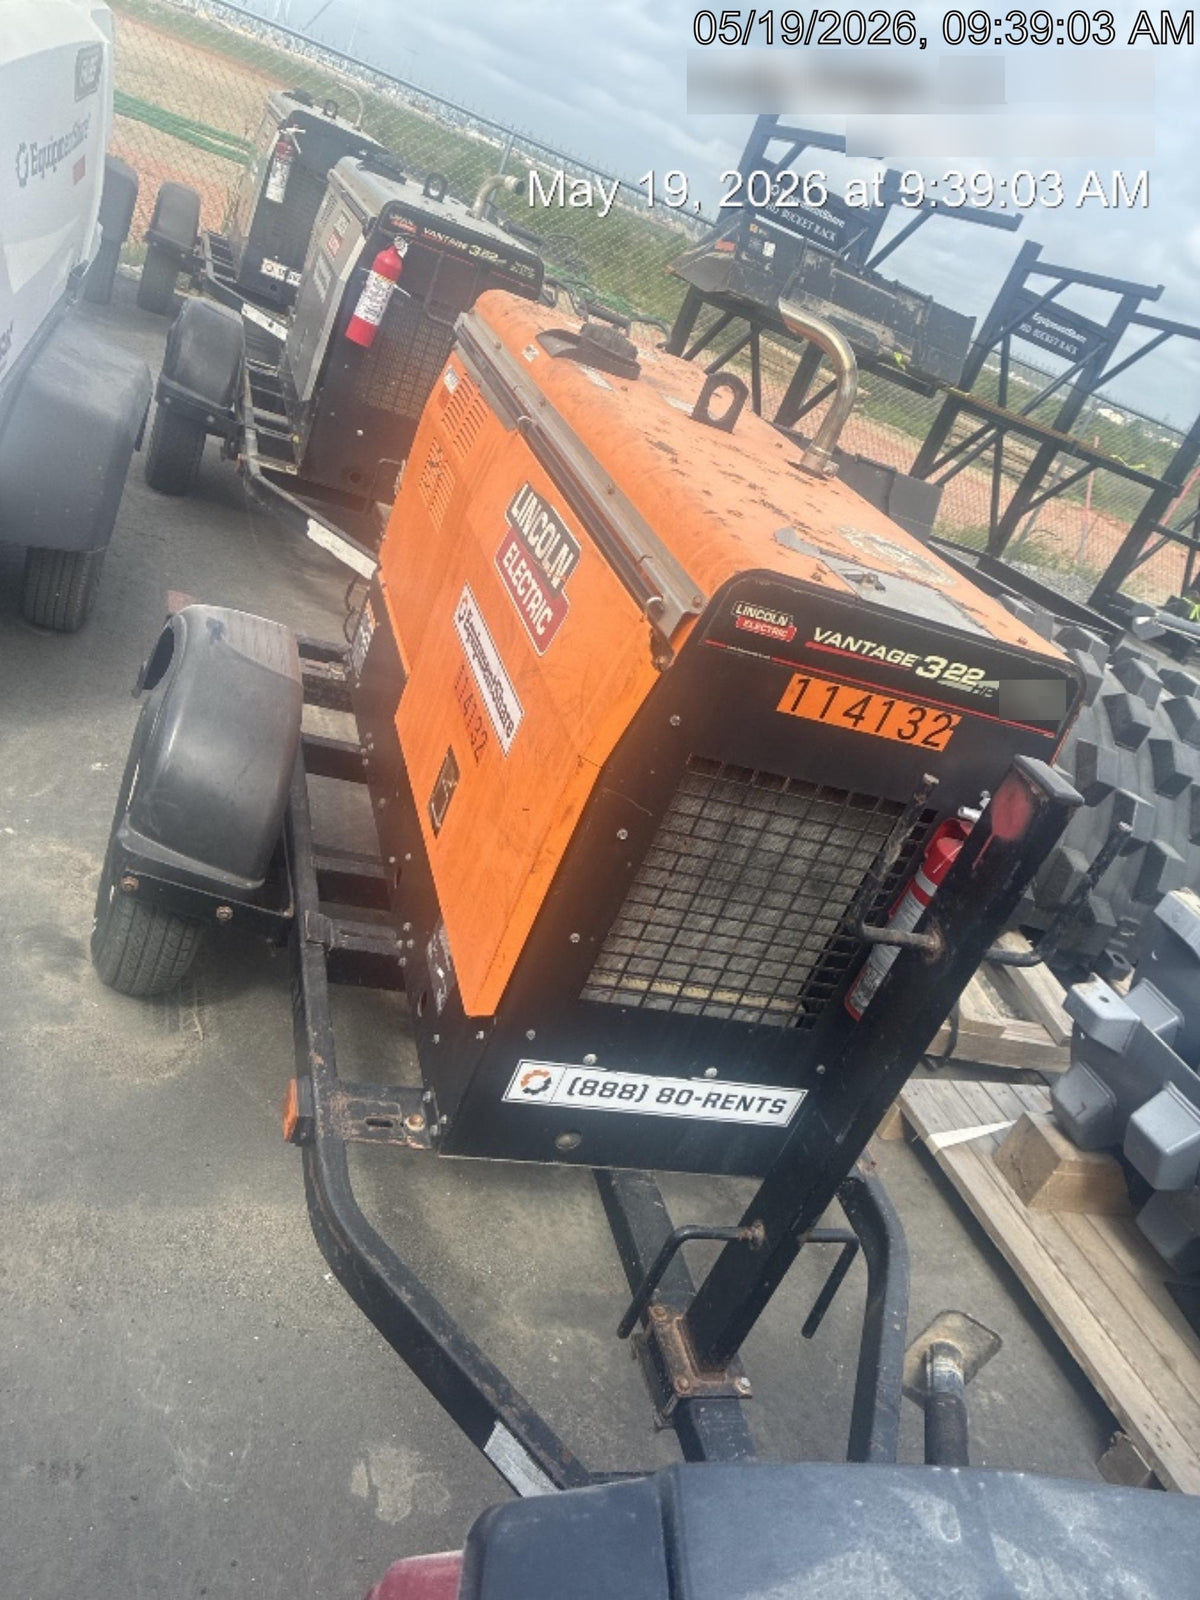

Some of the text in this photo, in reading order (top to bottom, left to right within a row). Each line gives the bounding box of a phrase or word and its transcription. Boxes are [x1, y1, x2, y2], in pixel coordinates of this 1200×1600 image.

[511, 483, 575, 590] LINCOLN
[502, 541, 554, 636] ELECTRIC
[735, 603, 789, 627] LINCOLN
[742, 619, 789, 638] ELECTRIC
[813, 626, 919, 669] VANTAGE
[914, 655, 986, 685] 322
[463, 608, 515, 739] EquipmentShare
[790, 678, 953, 748] 114132
[566, 1076, 788, 1115] (888) 80-RENTS
